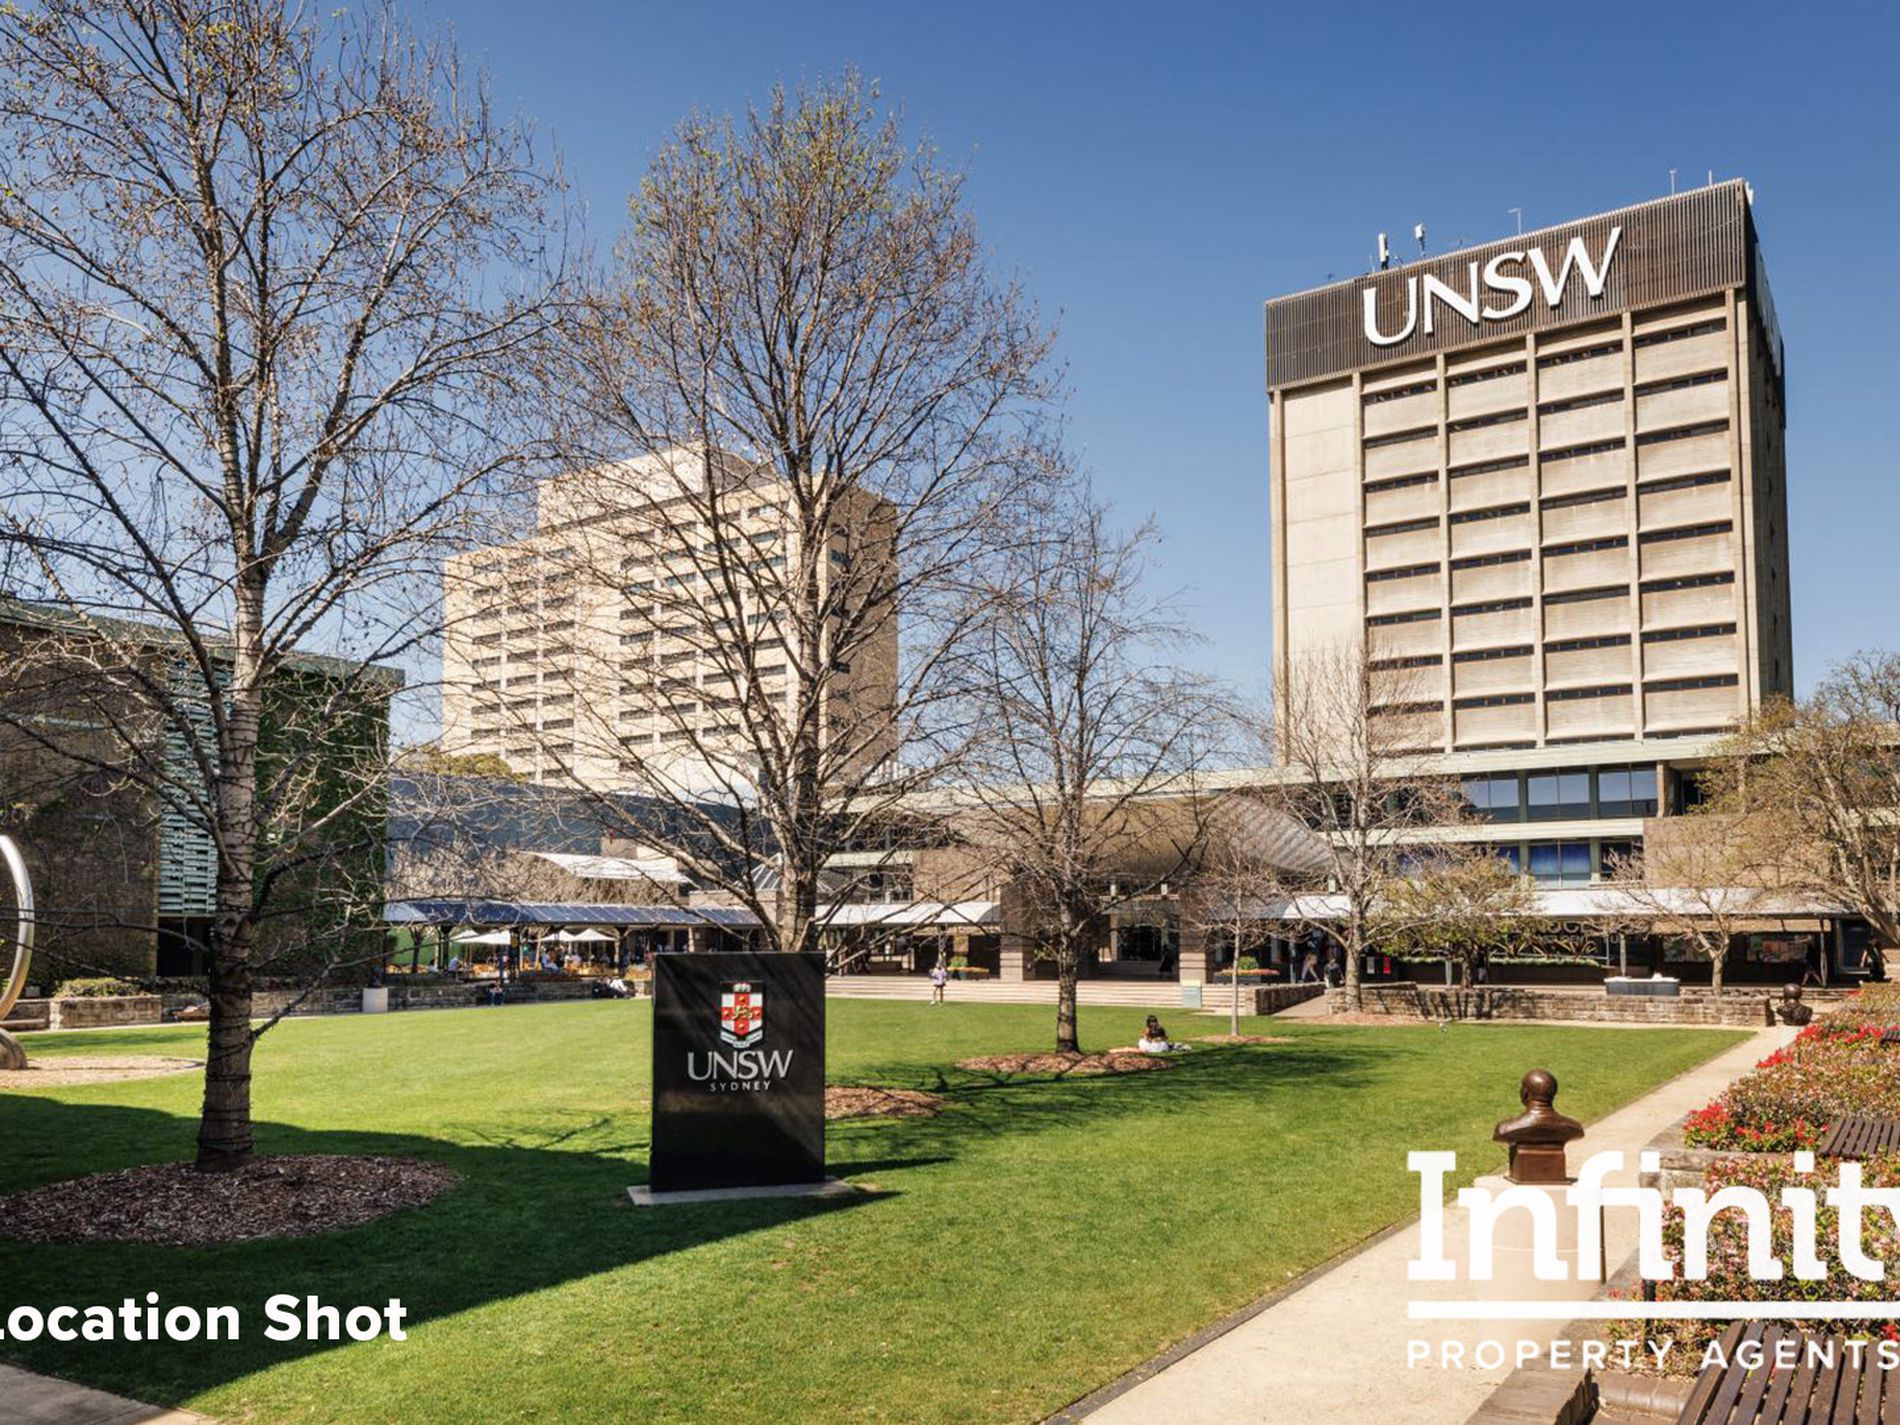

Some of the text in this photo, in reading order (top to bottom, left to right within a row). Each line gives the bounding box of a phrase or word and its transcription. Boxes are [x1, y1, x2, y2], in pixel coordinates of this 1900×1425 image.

[1363, 226, 1622, 345] UNSW
[687, 1049, 794, 1081] UNSW
[710, 1080, 771, 1092] SYDNEY
